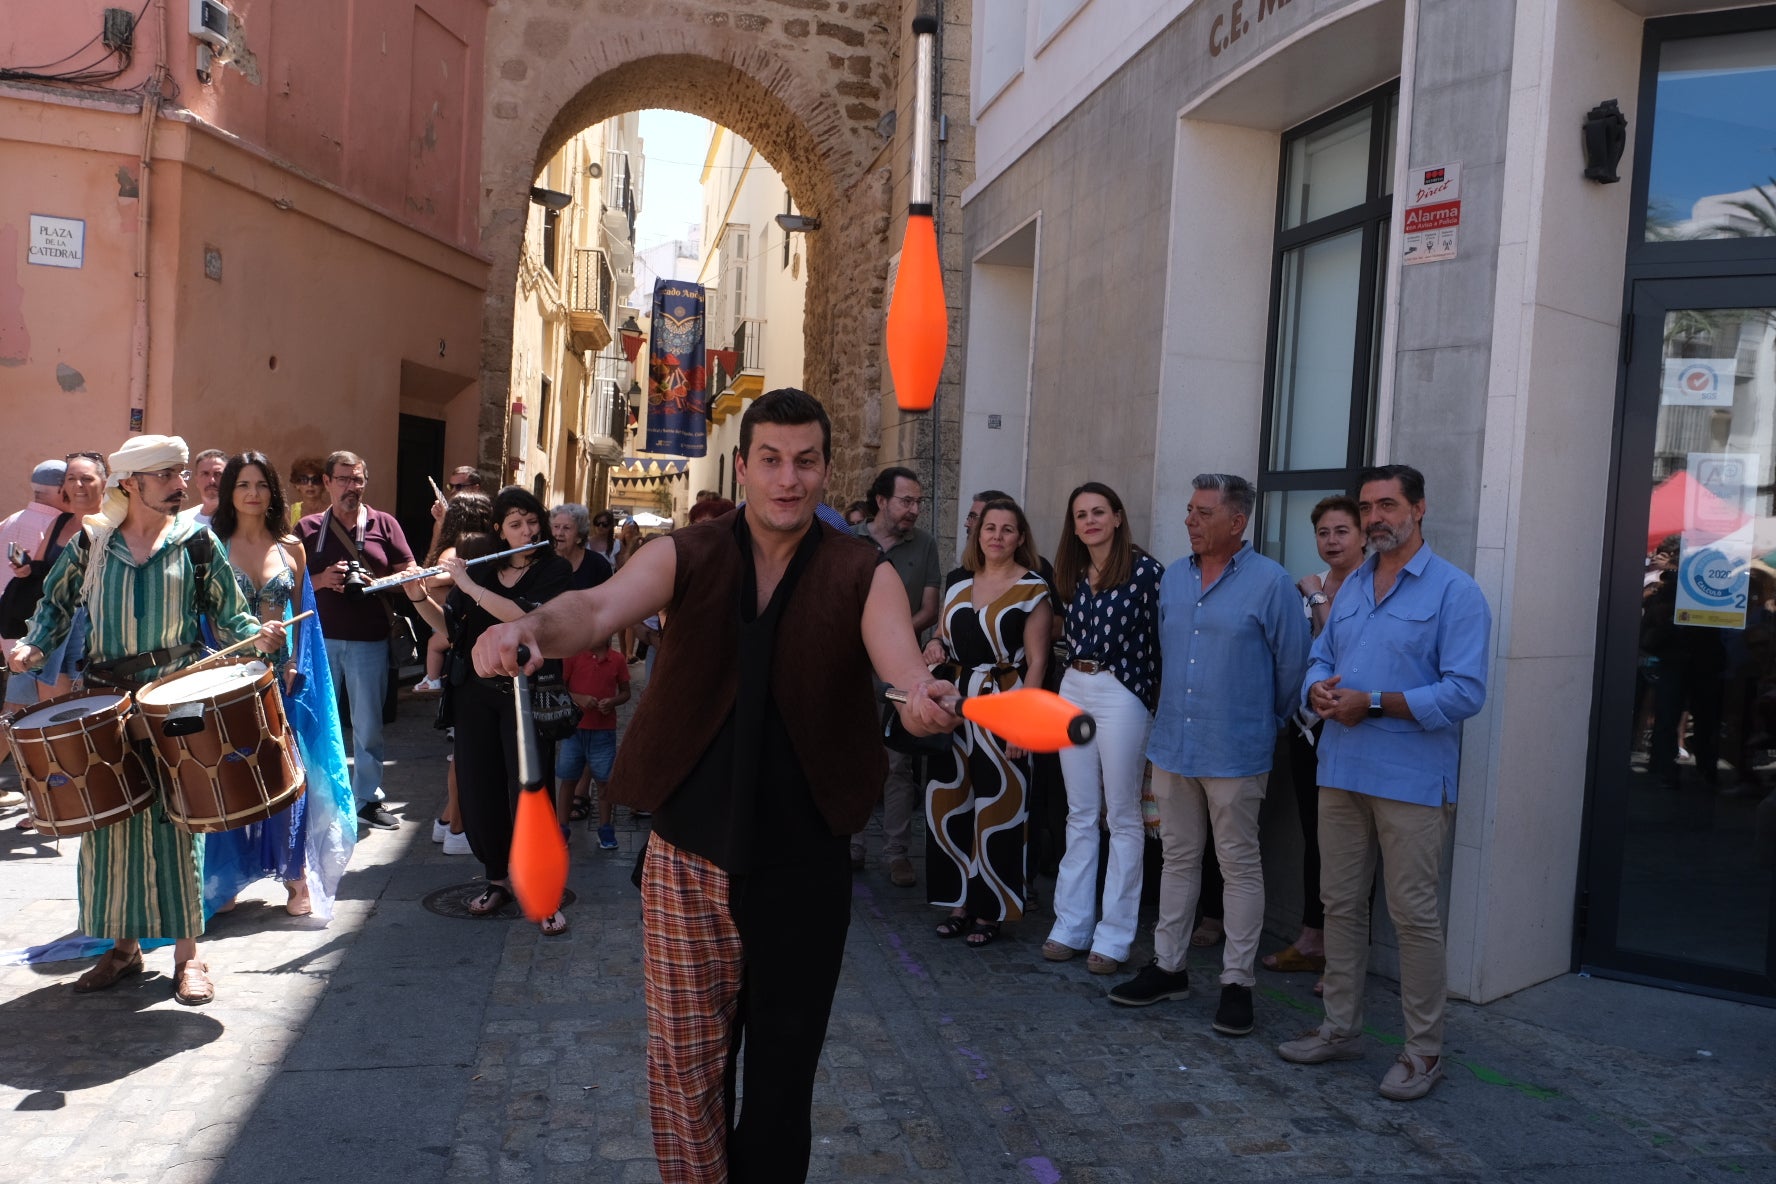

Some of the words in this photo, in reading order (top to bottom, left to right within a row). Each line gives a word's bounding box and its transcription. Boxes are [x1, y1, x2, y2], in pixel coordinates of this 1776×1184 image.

[1209, 0, 1249, 57] C.E.
[1416, 179, 1454, 203] Direct
[1406, 207, 1458, 225] Alarma
[39, 225, 73, 239] PLAZA
[45, 238, 56, 246] DE
[57, 239, 67, 247] LA
[29, 246, 80, 259] CATEDRAL
[439, 339, 446, 358] 2
[1734, 593, 1747, 609] 2
